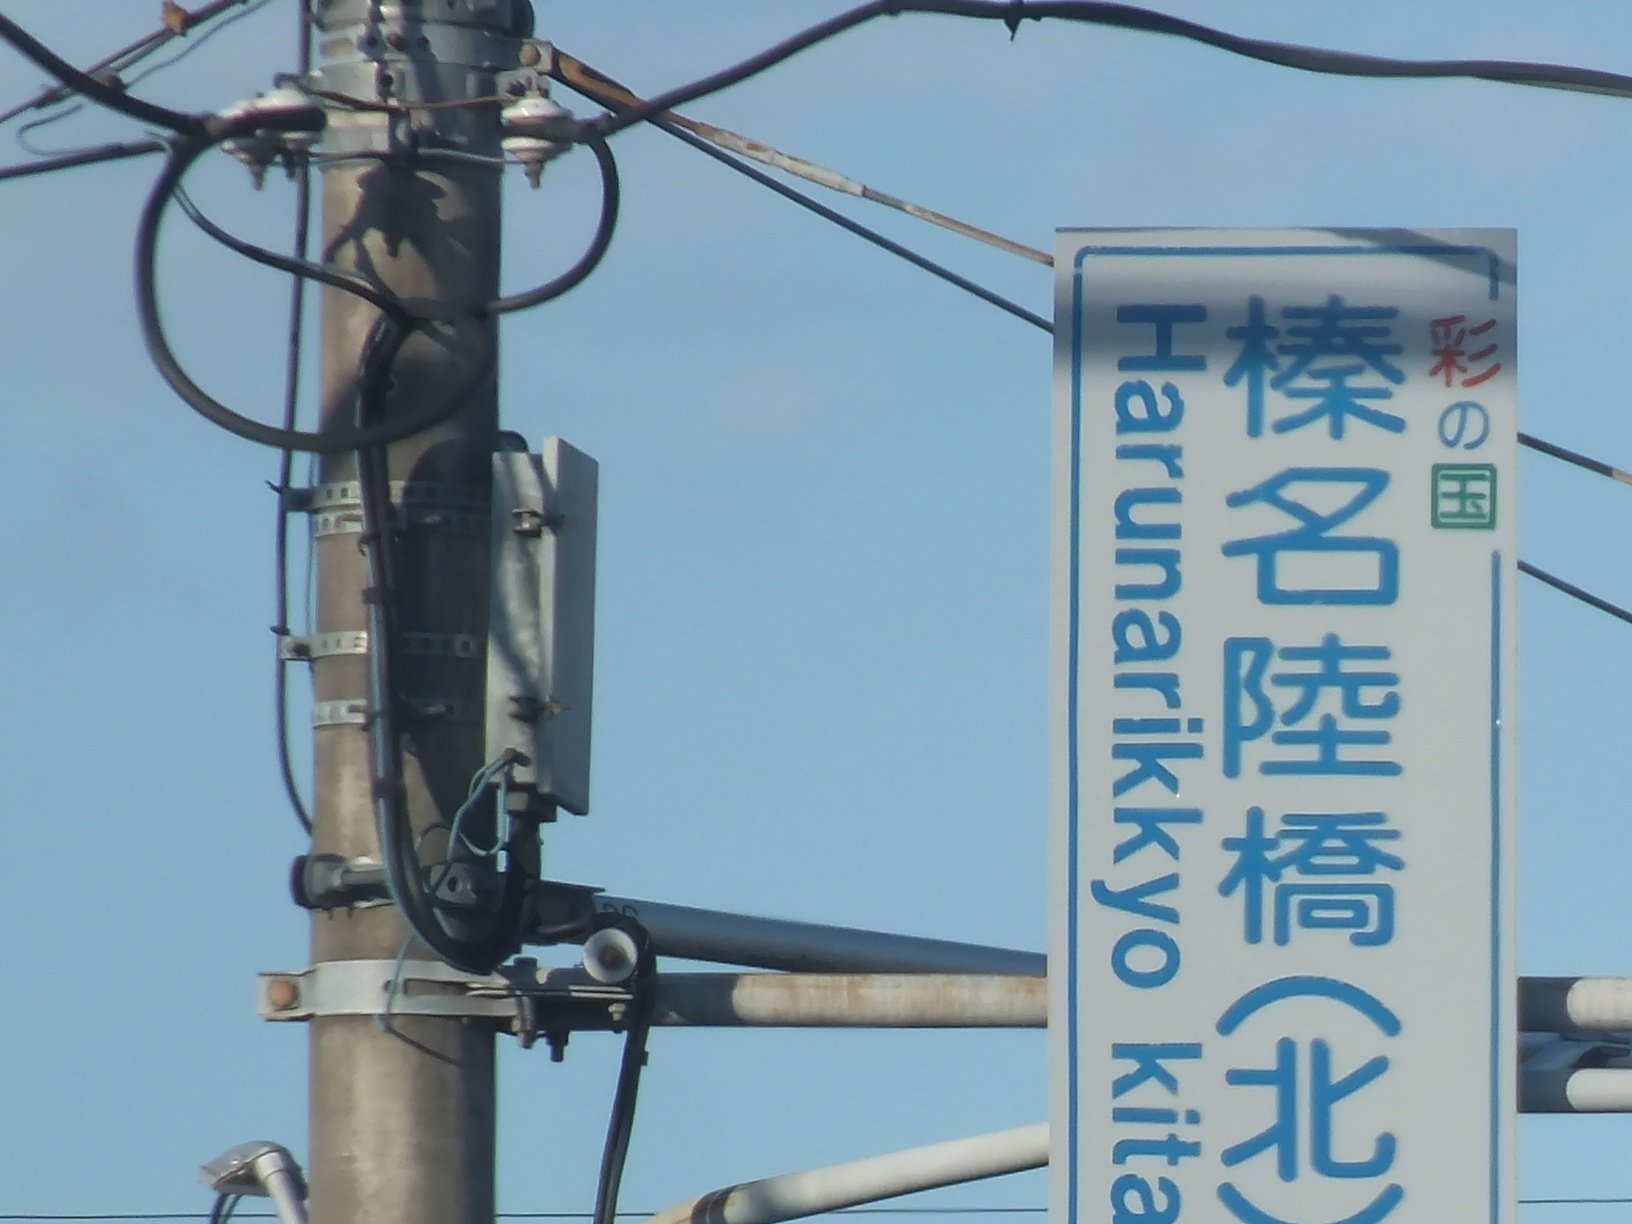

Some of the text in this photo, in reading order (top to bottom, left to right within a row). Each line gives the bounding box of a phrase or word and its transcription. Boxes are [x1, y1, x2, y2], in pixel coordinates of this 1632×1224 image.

[1091, 303, 1207, 990] Harunarikkyo
[1428, 314, 1501, 530] 彩の国
